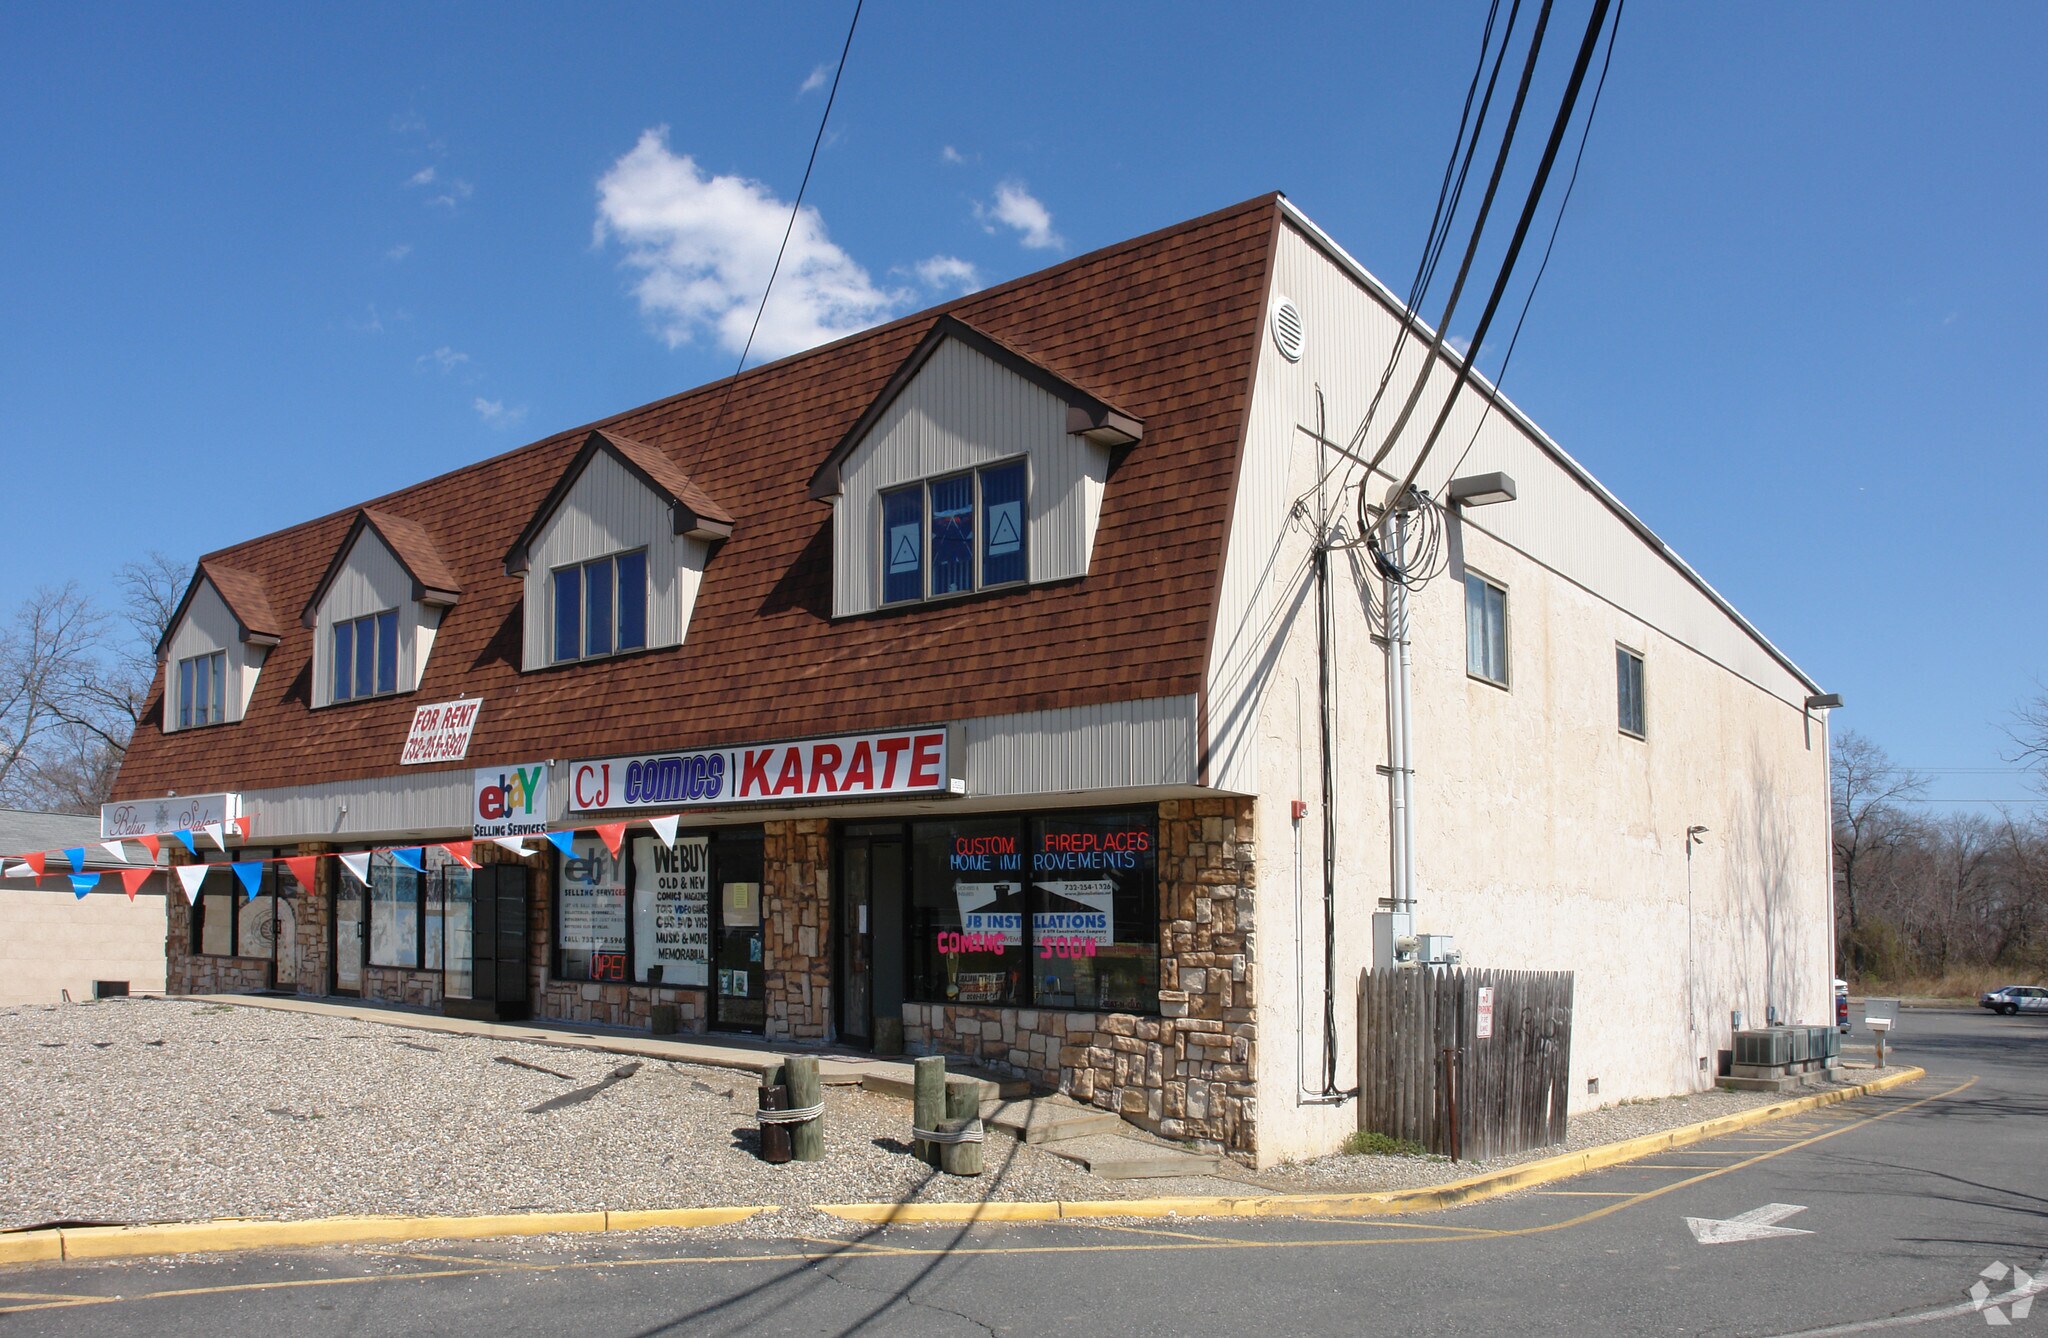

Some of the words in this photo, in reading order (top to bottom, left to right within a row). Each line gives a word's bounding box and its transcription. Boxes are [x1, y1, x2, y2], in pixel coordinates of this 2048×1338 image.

[413, 709, 440, 732] FOR
[441, 704, 477, 729] RENT
[575, 764, 609, 809] CJ
[623, 752, 725, 804] COMICS
[739, 733, 944, 797] KARATE
[110, 805, 146, 836] Belisa
[474, 824, 506, 837] SELLING
[508, 822, 546, 836] SERVICES
[956, 835, 1015, 855] CUSTOM
[1045, 832, 1149, 851] FIREPLACES
[950, 854, 991, 871] HOME
[658, 877, 678, 889] OLD
[680, 876, 687, 889] &
[656, 892, 681, 901] COMICS
[966, 915, 983, 929] JB
[987, 915, 1106, 929] INSTLLATIONS
[655, 932, 679, 944] MUSIC
[682, 932, 688, 944] &
[937, 931, 1005, 957] COMING
[1040, 936, 1098, 960] SOON
